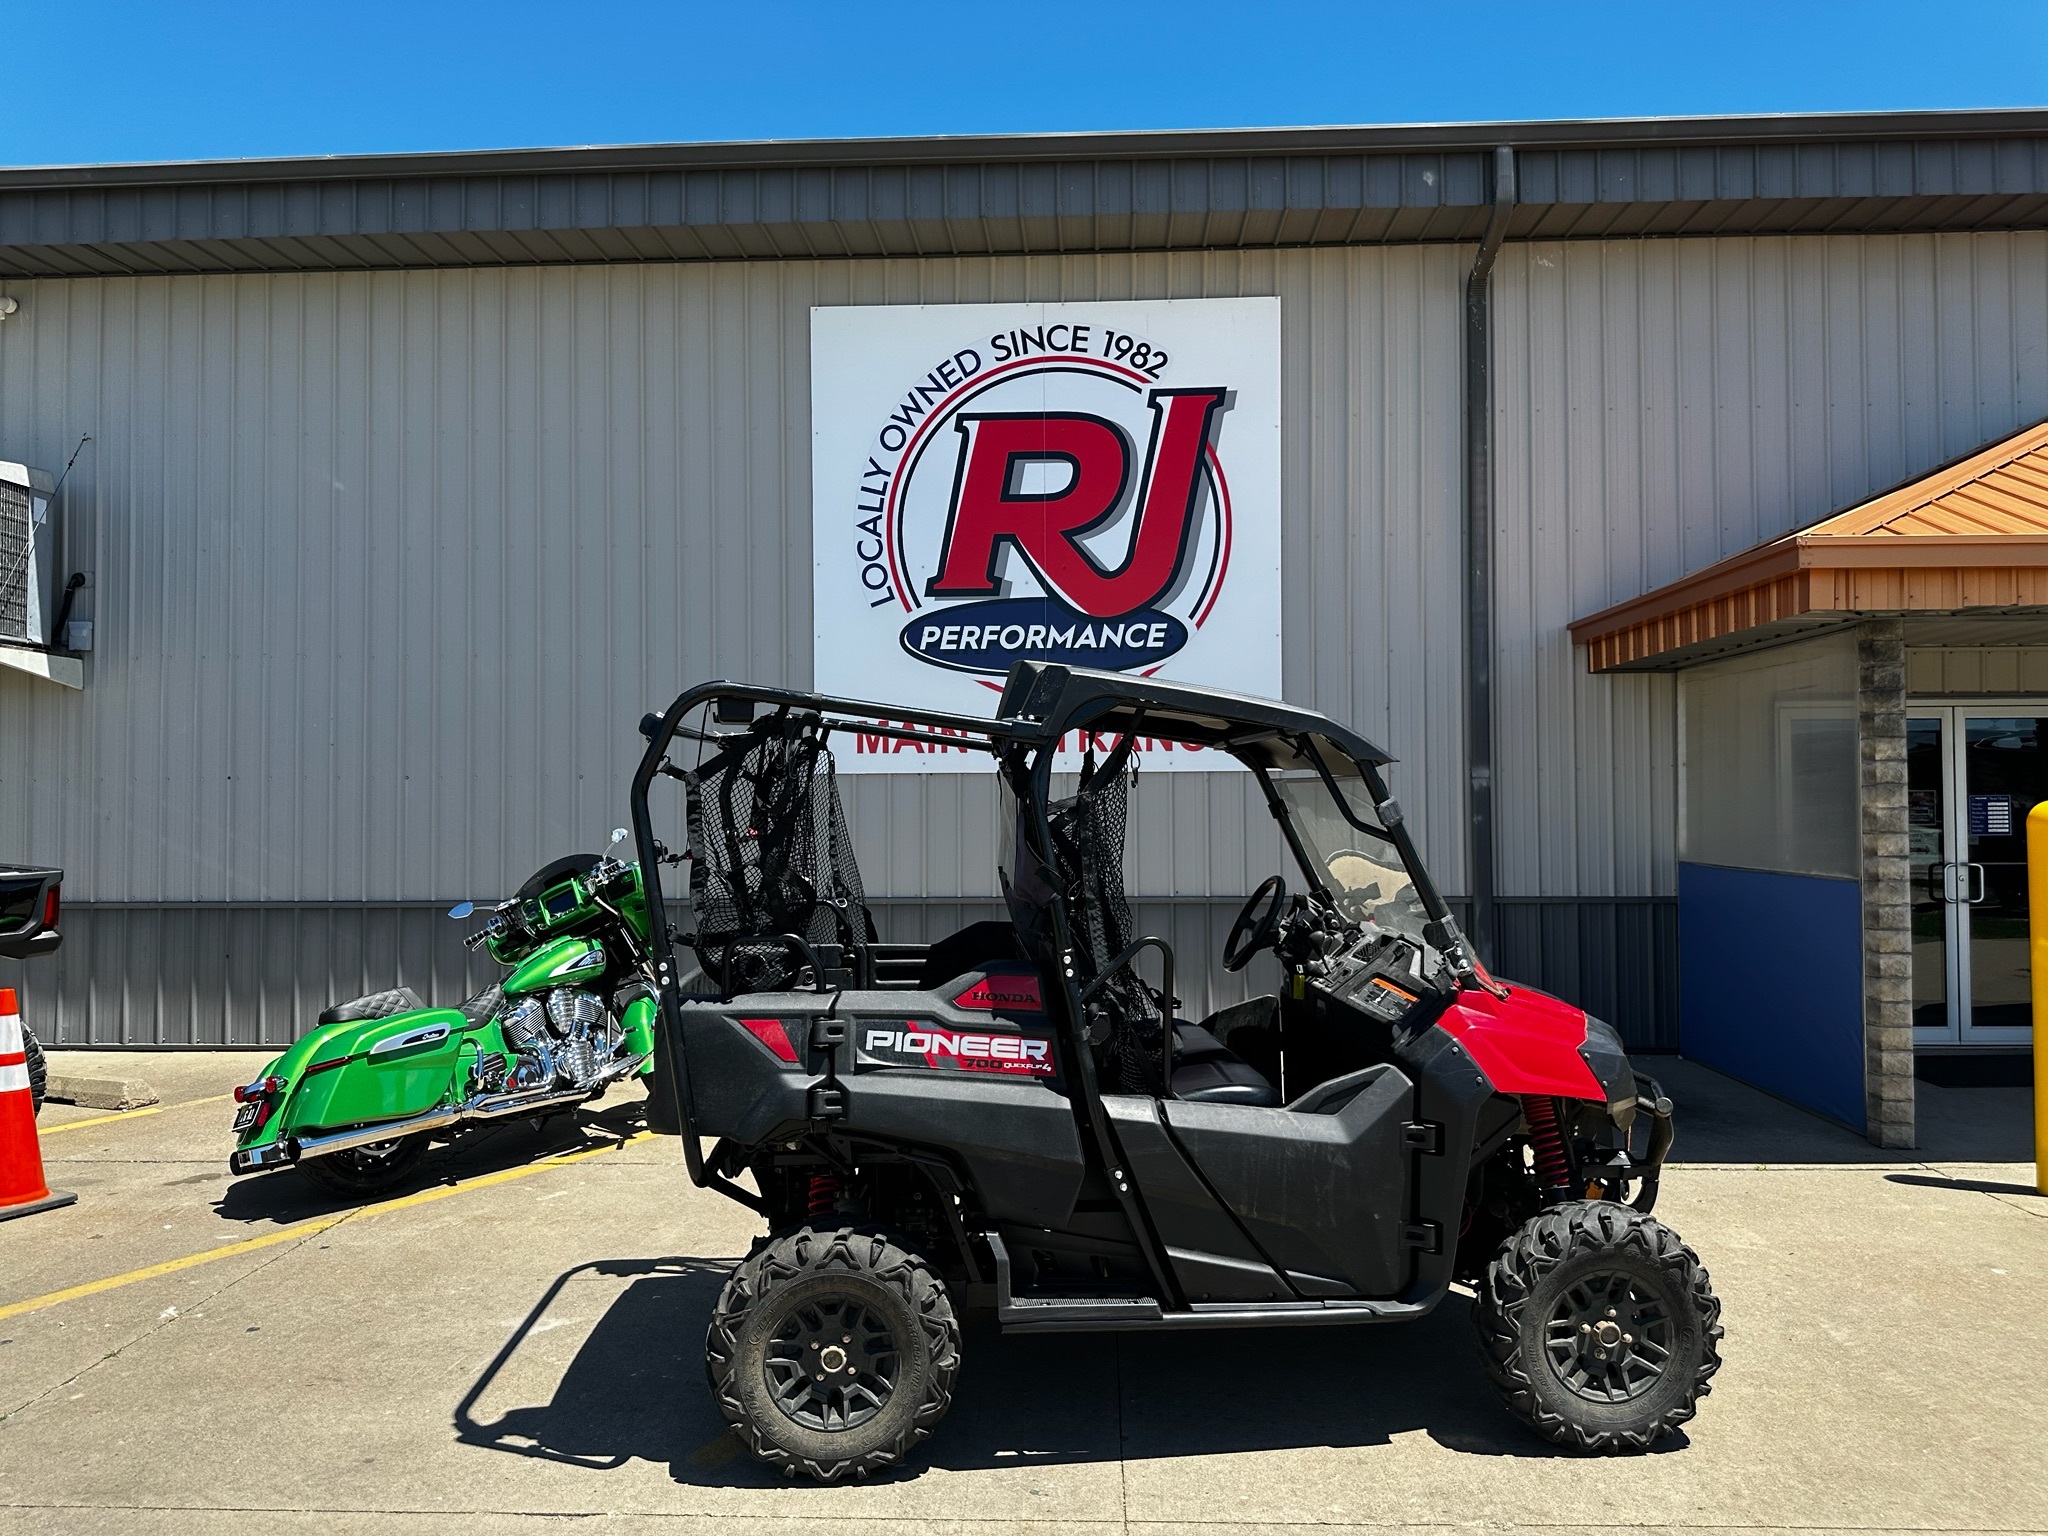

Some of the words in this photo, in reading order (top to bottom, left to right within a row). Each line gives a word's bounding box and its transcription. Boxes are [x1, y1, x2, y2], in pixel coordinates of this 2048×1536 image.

[856, 456, 896, 608] LOCALLY
[879, 349, 981, 452] OWNED
[990, 324, 1090, 362] SINCE
[1103, 330, 1168, 380] 1982
[925, 386, 1230, 621] RJ
[919, 622, 1168, 651] PERFORMANCE
[971, 991, 1037, 1004] HONDA
[865, 1029, 1048, 1061] PIONEER
[962, 1058, 1003, 1069] 700
